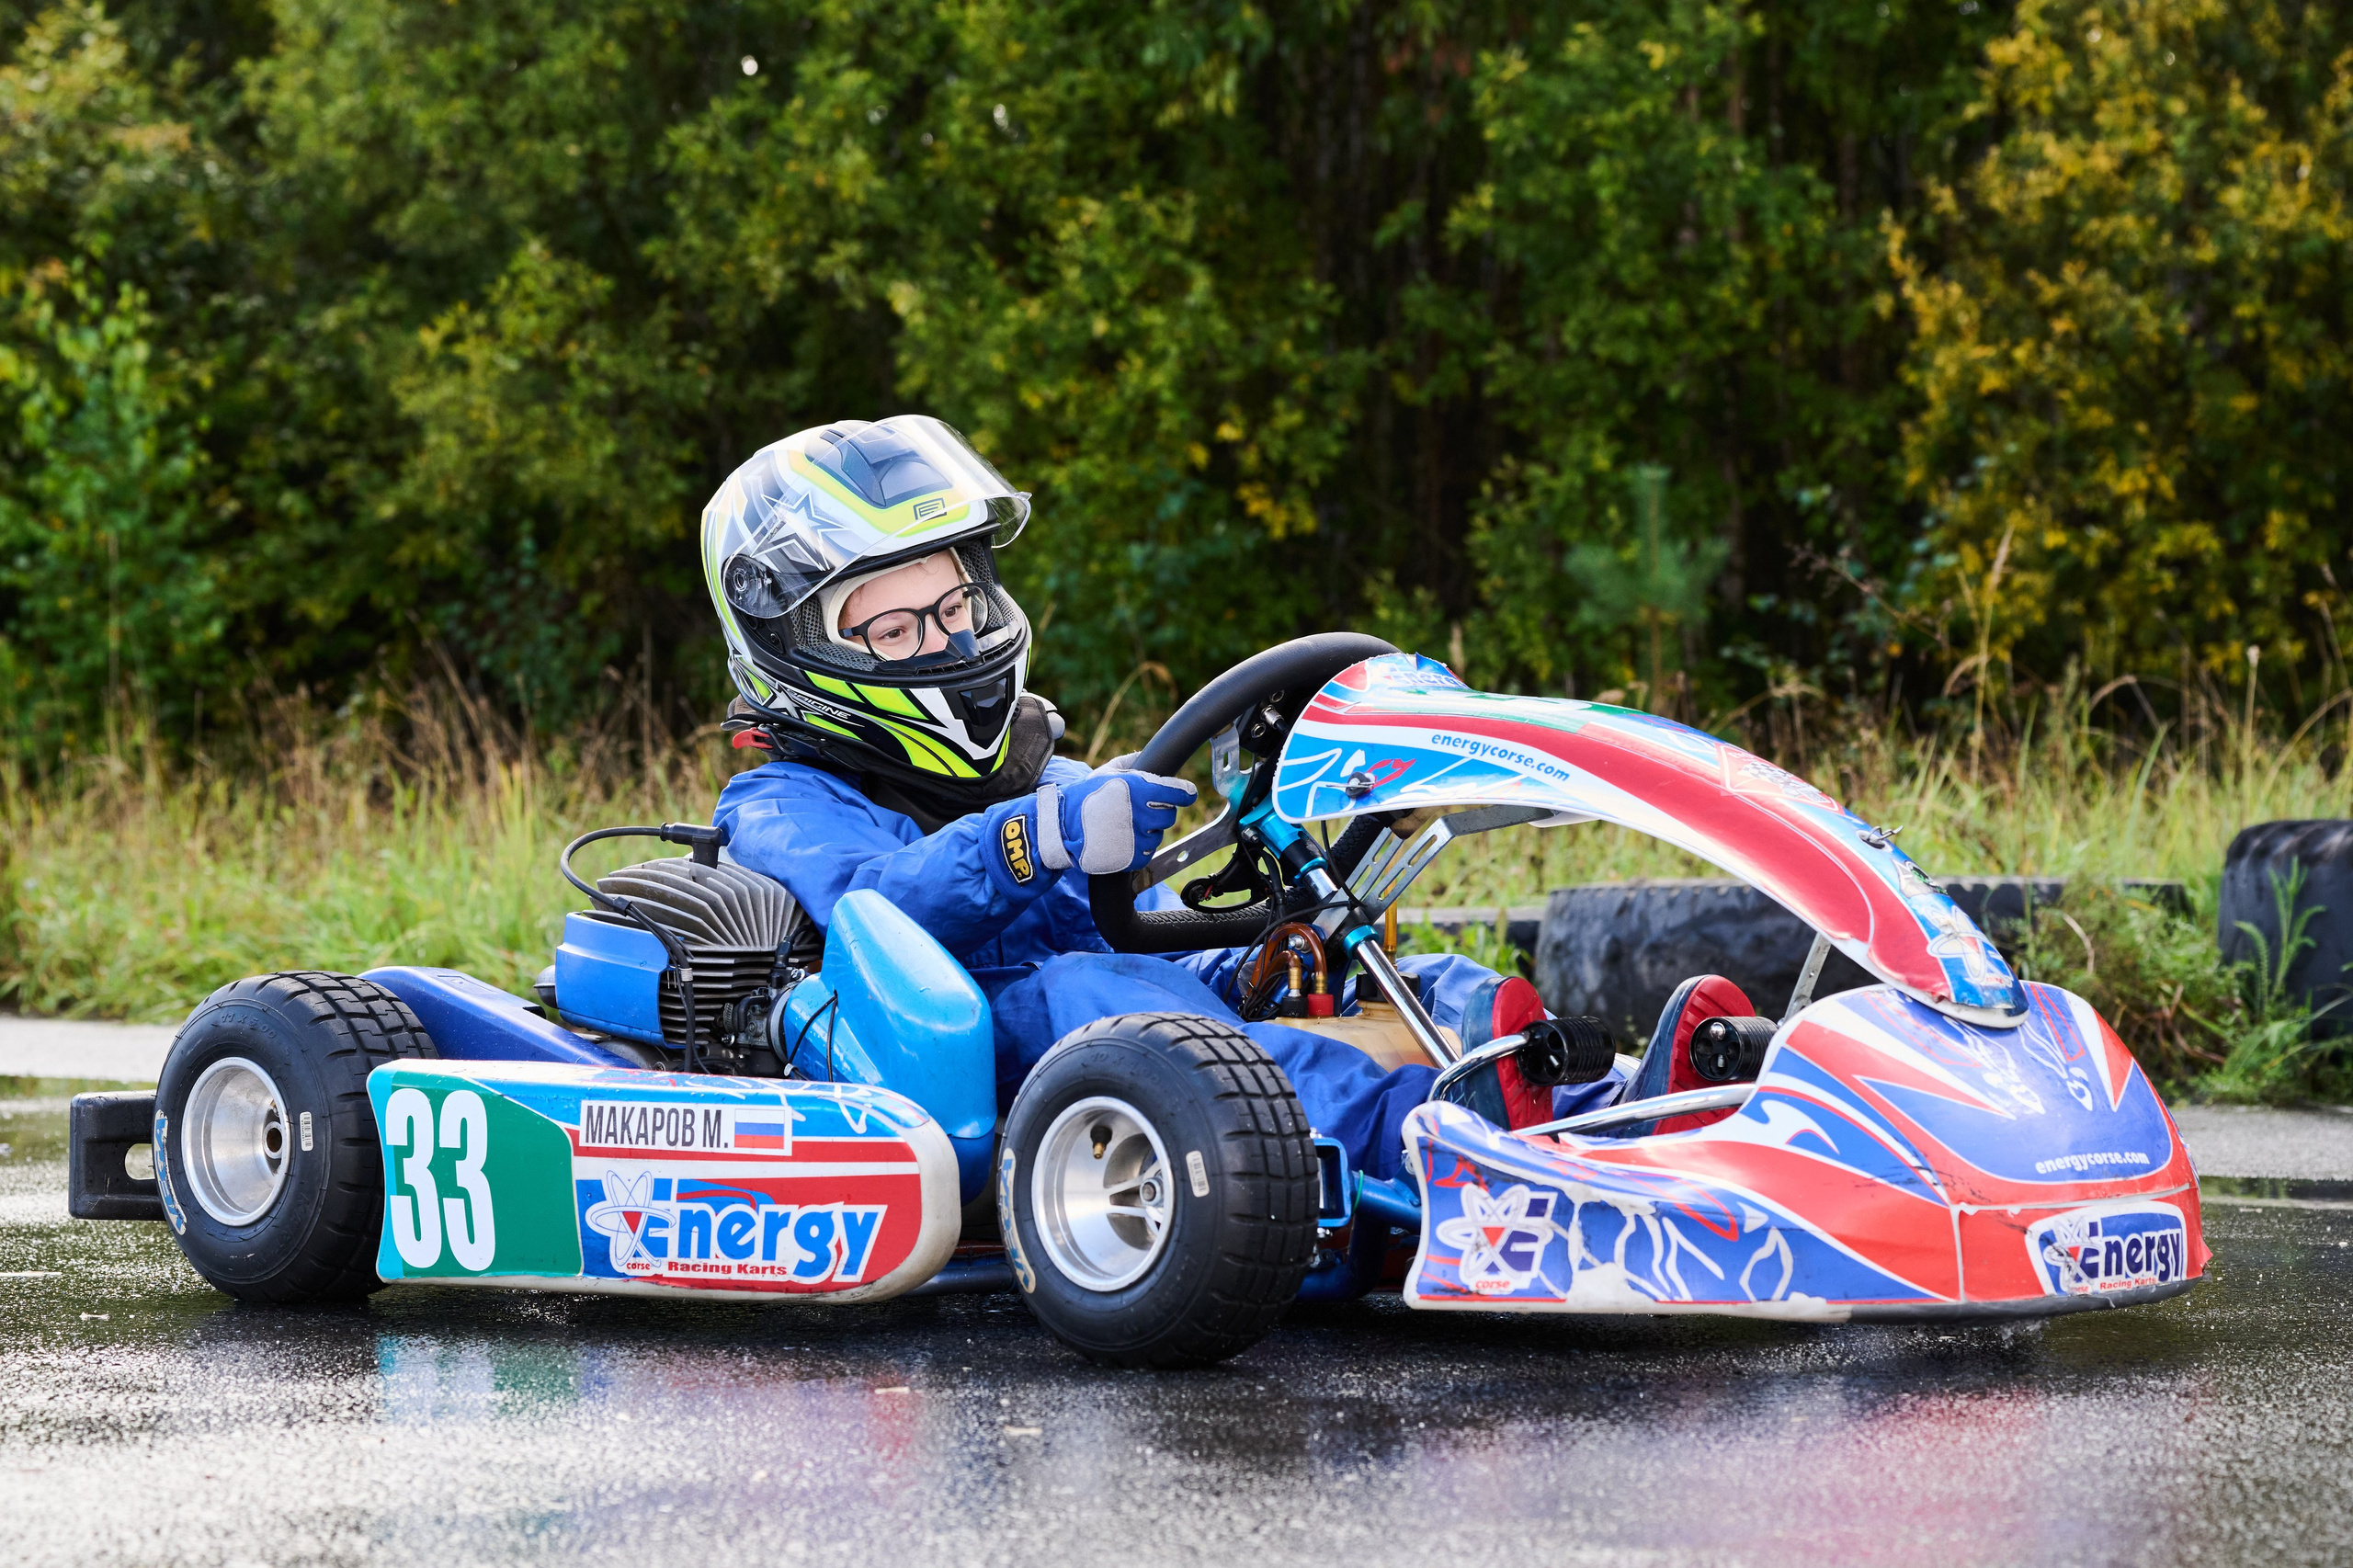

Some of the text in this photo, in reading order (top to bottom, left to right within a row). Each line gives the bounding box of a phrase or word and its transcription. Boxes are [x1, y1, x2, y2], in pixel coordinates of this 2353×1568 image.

[787, 688, 852, 720] ORIGINE
[1431, 734, 1570, 781] energycorse.com
[1006, 821, 1030, 877] OMP
[585, 1105, 729, 1149] МАКАРОВ М.
[385, 1087, 496, 1272] 33
[2035, 1152, 2151, 1175] energycorse.com
[631, 1177, 880, 1278] Energy
[1000, 1158, 1030, 1290] VEGA
[626, 1262, 651, 1270] corse
[667, 1261, 788, 1276] Racing Karts
[2073, 1221, 2181, 1282] Energy
[1475, 1280, 1510, 1290] corse
[2099, 1276, 2157, 1291] Racing Karts
